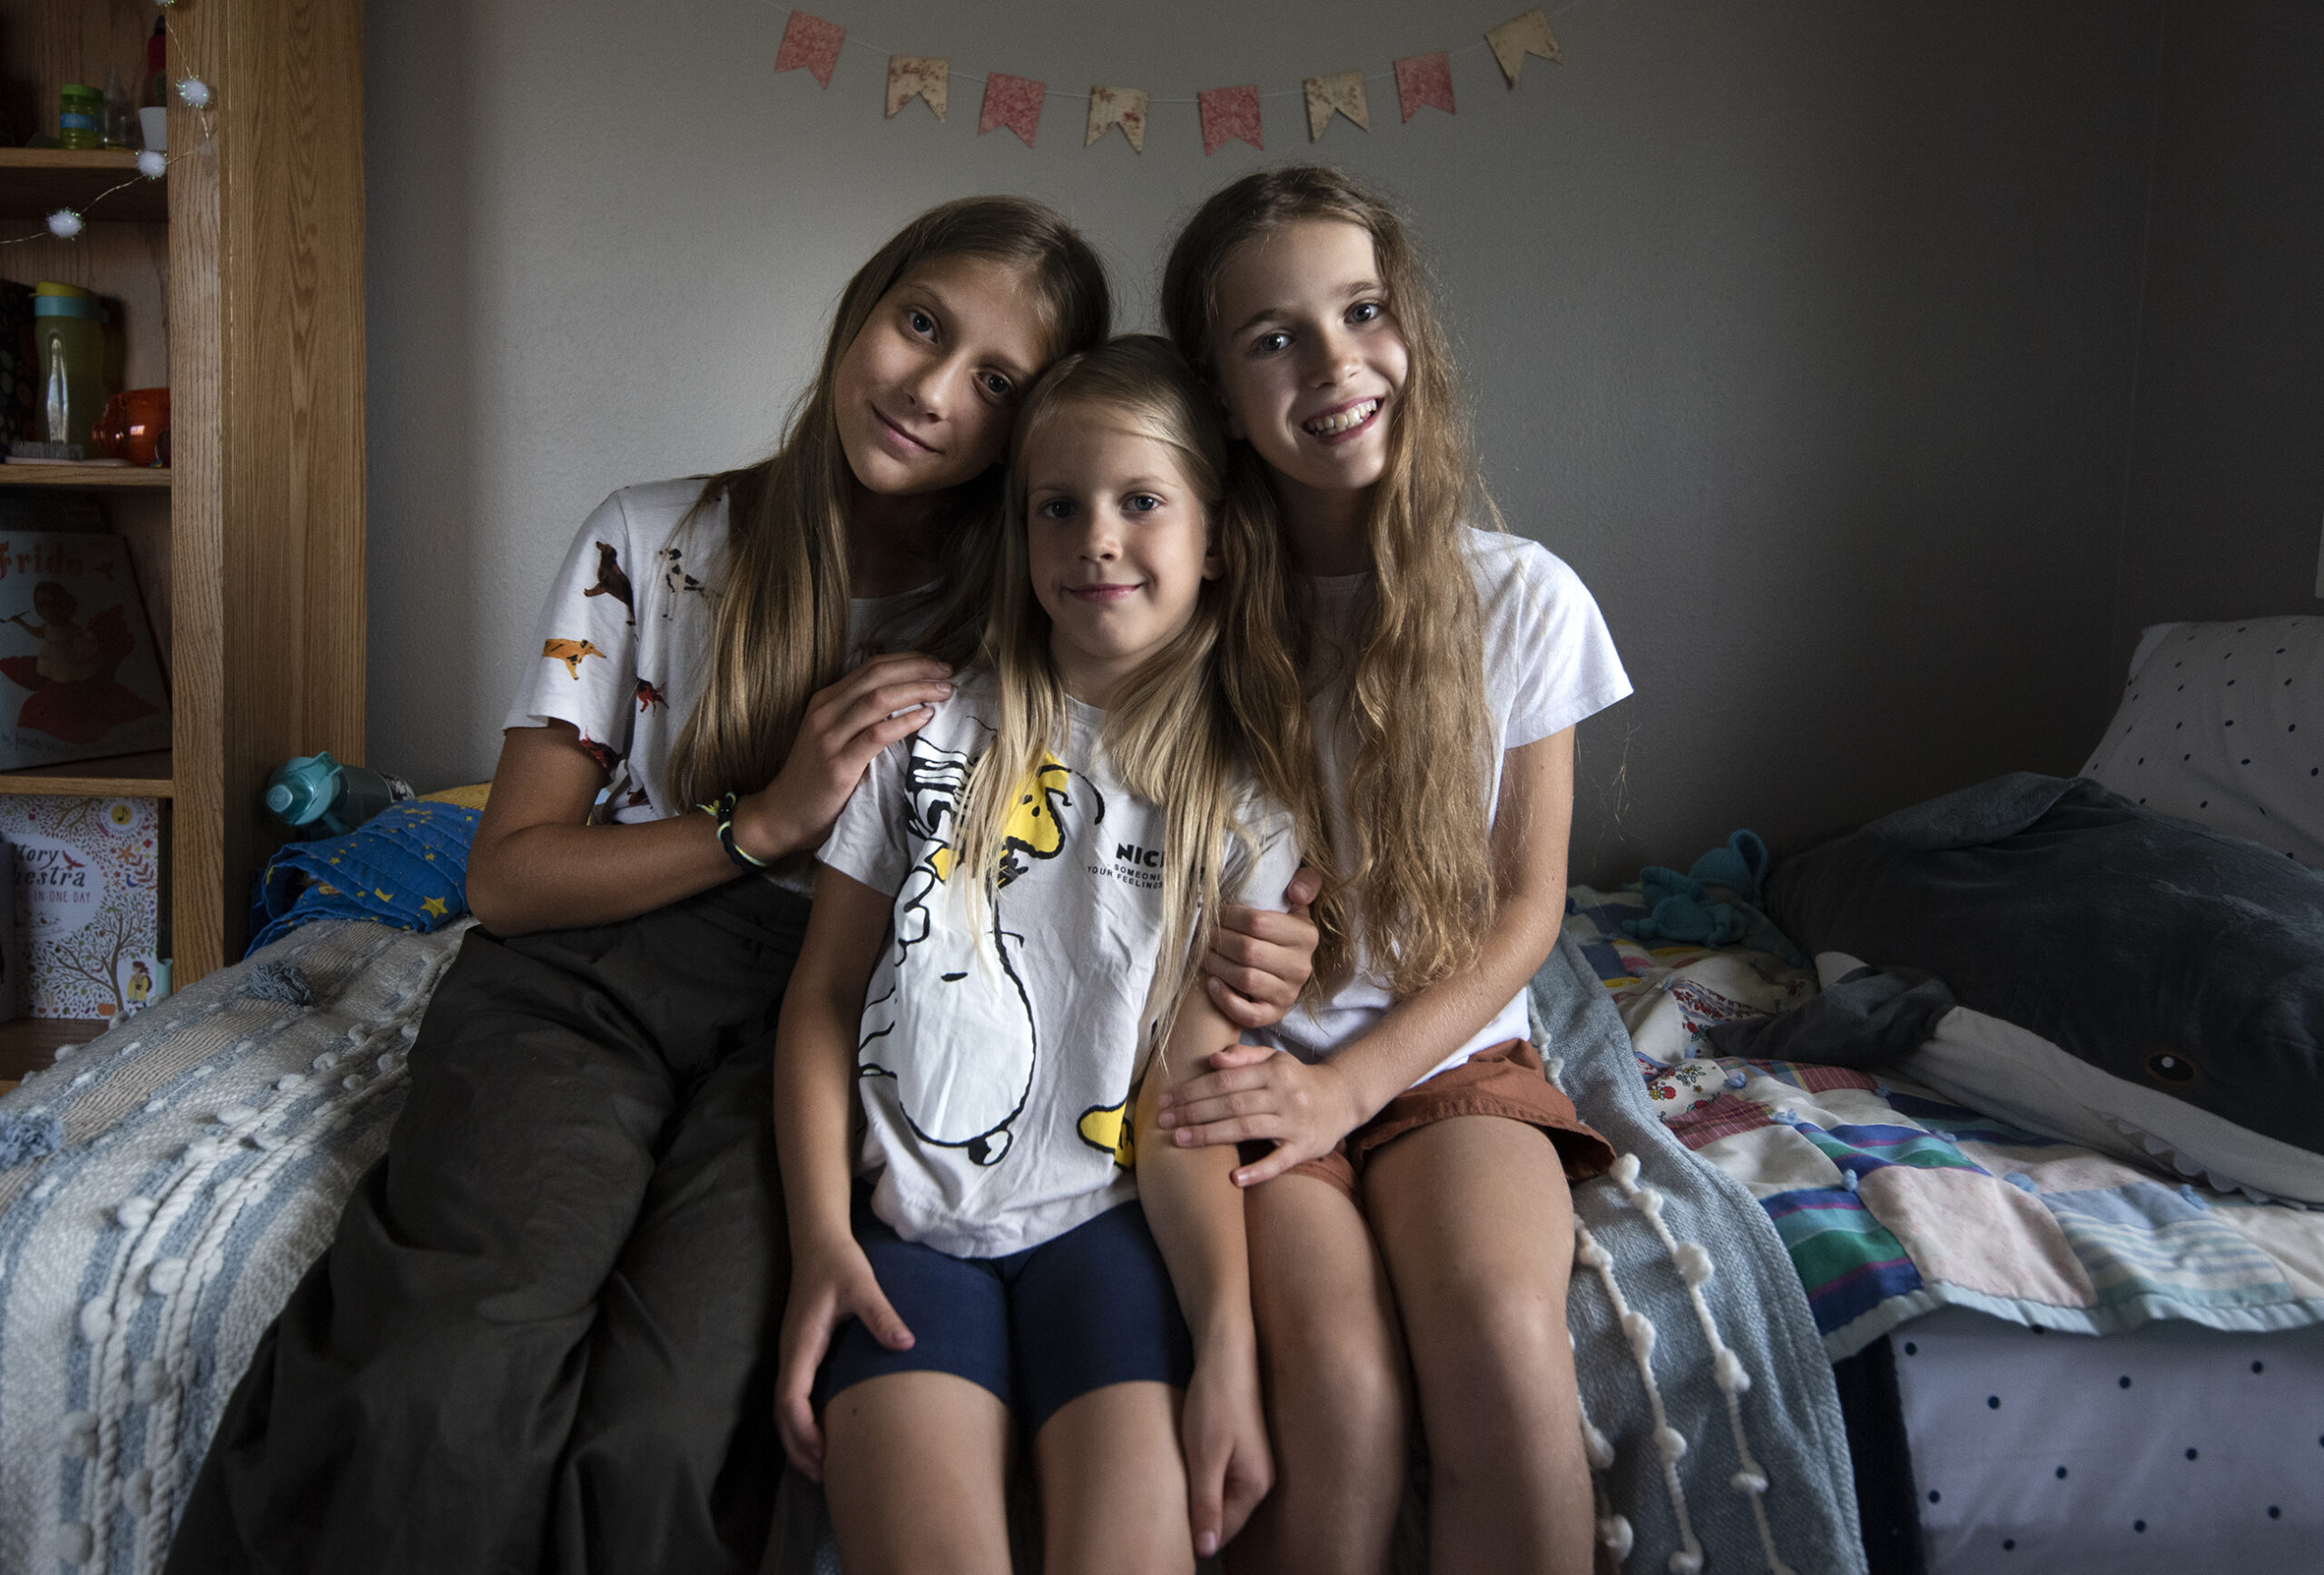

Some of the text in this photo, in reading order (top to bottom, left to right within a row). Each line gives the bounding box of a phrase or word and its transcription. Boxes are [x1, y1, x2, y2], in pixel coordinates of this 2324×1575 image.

[14, 843, 59, 871] tory
[1116, 842, 1164, 869] NIC
[13, 863, 85, 888] hestra
[1087, 865, 1163, 890] YOUR FEELINGS
[34, 891, 44, 901] IN
[49, 891, 67, 902] ONE
[73, 891, 91, 903] DAY
